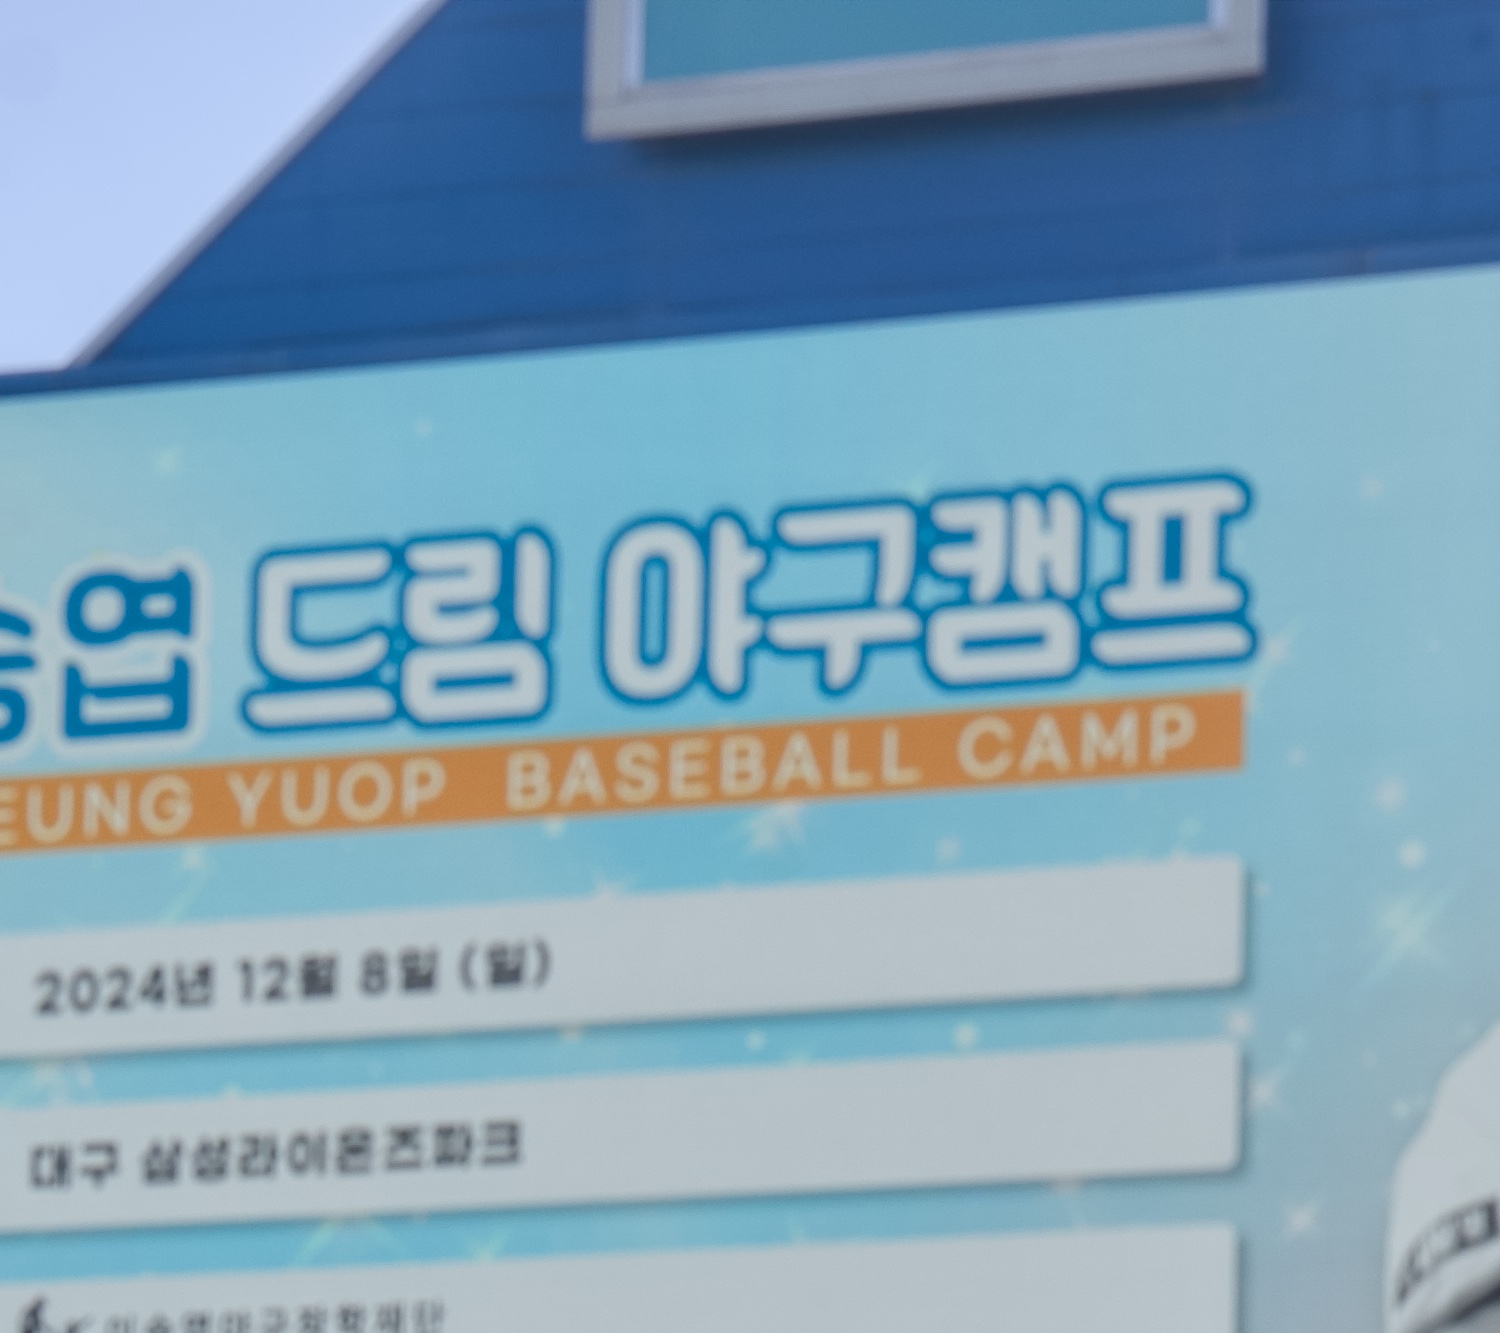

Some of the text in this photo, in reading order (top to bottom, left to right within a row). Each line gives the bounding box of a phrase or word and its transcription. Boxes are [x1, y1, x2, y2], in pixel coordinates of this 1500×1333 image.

[242, 526, 556, 735] 드림
[600, 472, 1258, 704] 야구캠프
[228, 759, 448, 834] YUOP
[507, 729, 920, 813] BASEBALL
[960, 706, 1198, 783] CAMP
[34, 962, 216, 1016] 2024년
[238, 954, 340, 1003] 12월
[360, 948, 438, 996] 8일
[28, 1120, 524, 1191] 대구 삼성라이온즈파크
